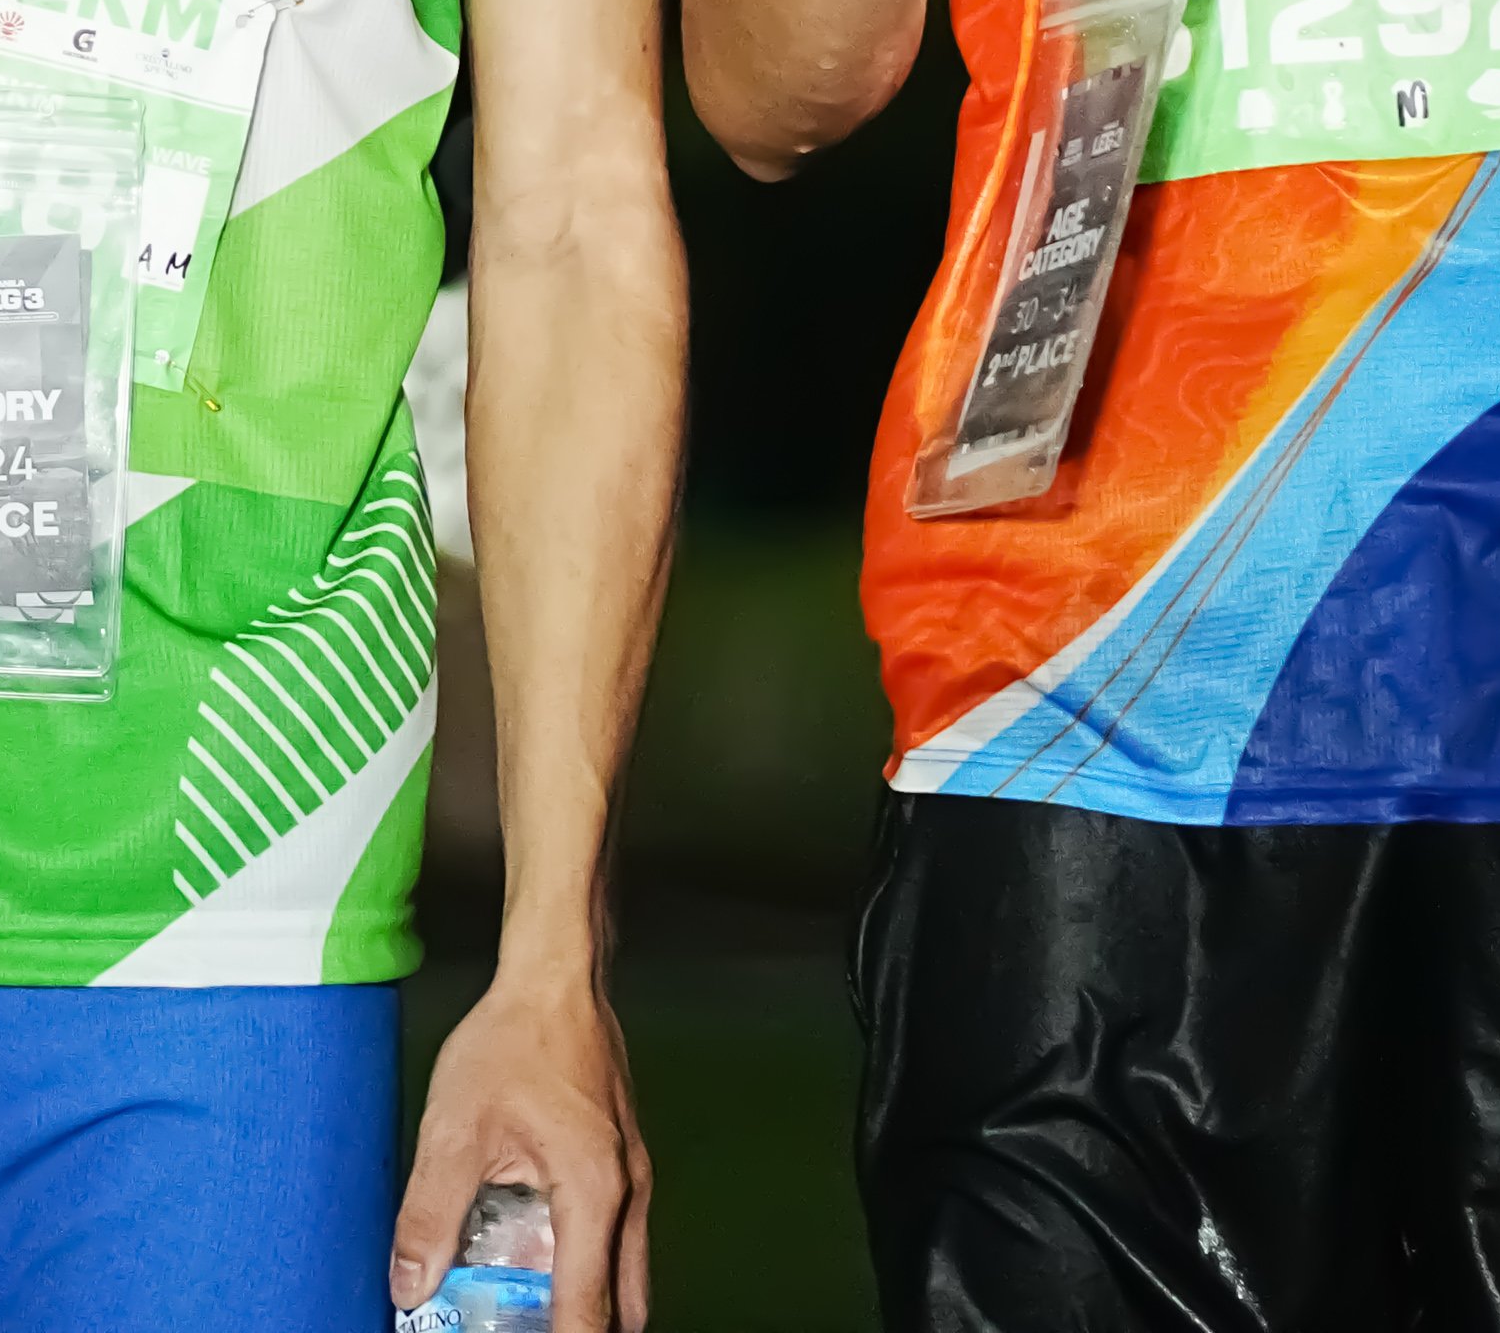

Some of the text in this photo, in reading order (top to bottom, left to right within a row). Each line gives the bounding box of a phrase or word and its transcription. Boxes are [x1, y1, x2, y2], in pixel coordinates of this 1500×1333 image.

[152, 145, 213, 175] WAVE
[1046, 198, 1090, 244] AGE
[1018, 226, 1105, 282] CATEGORY
[1011, 297, 1039, 334] 30
[1012, 329, 1080, 378] PLACE
